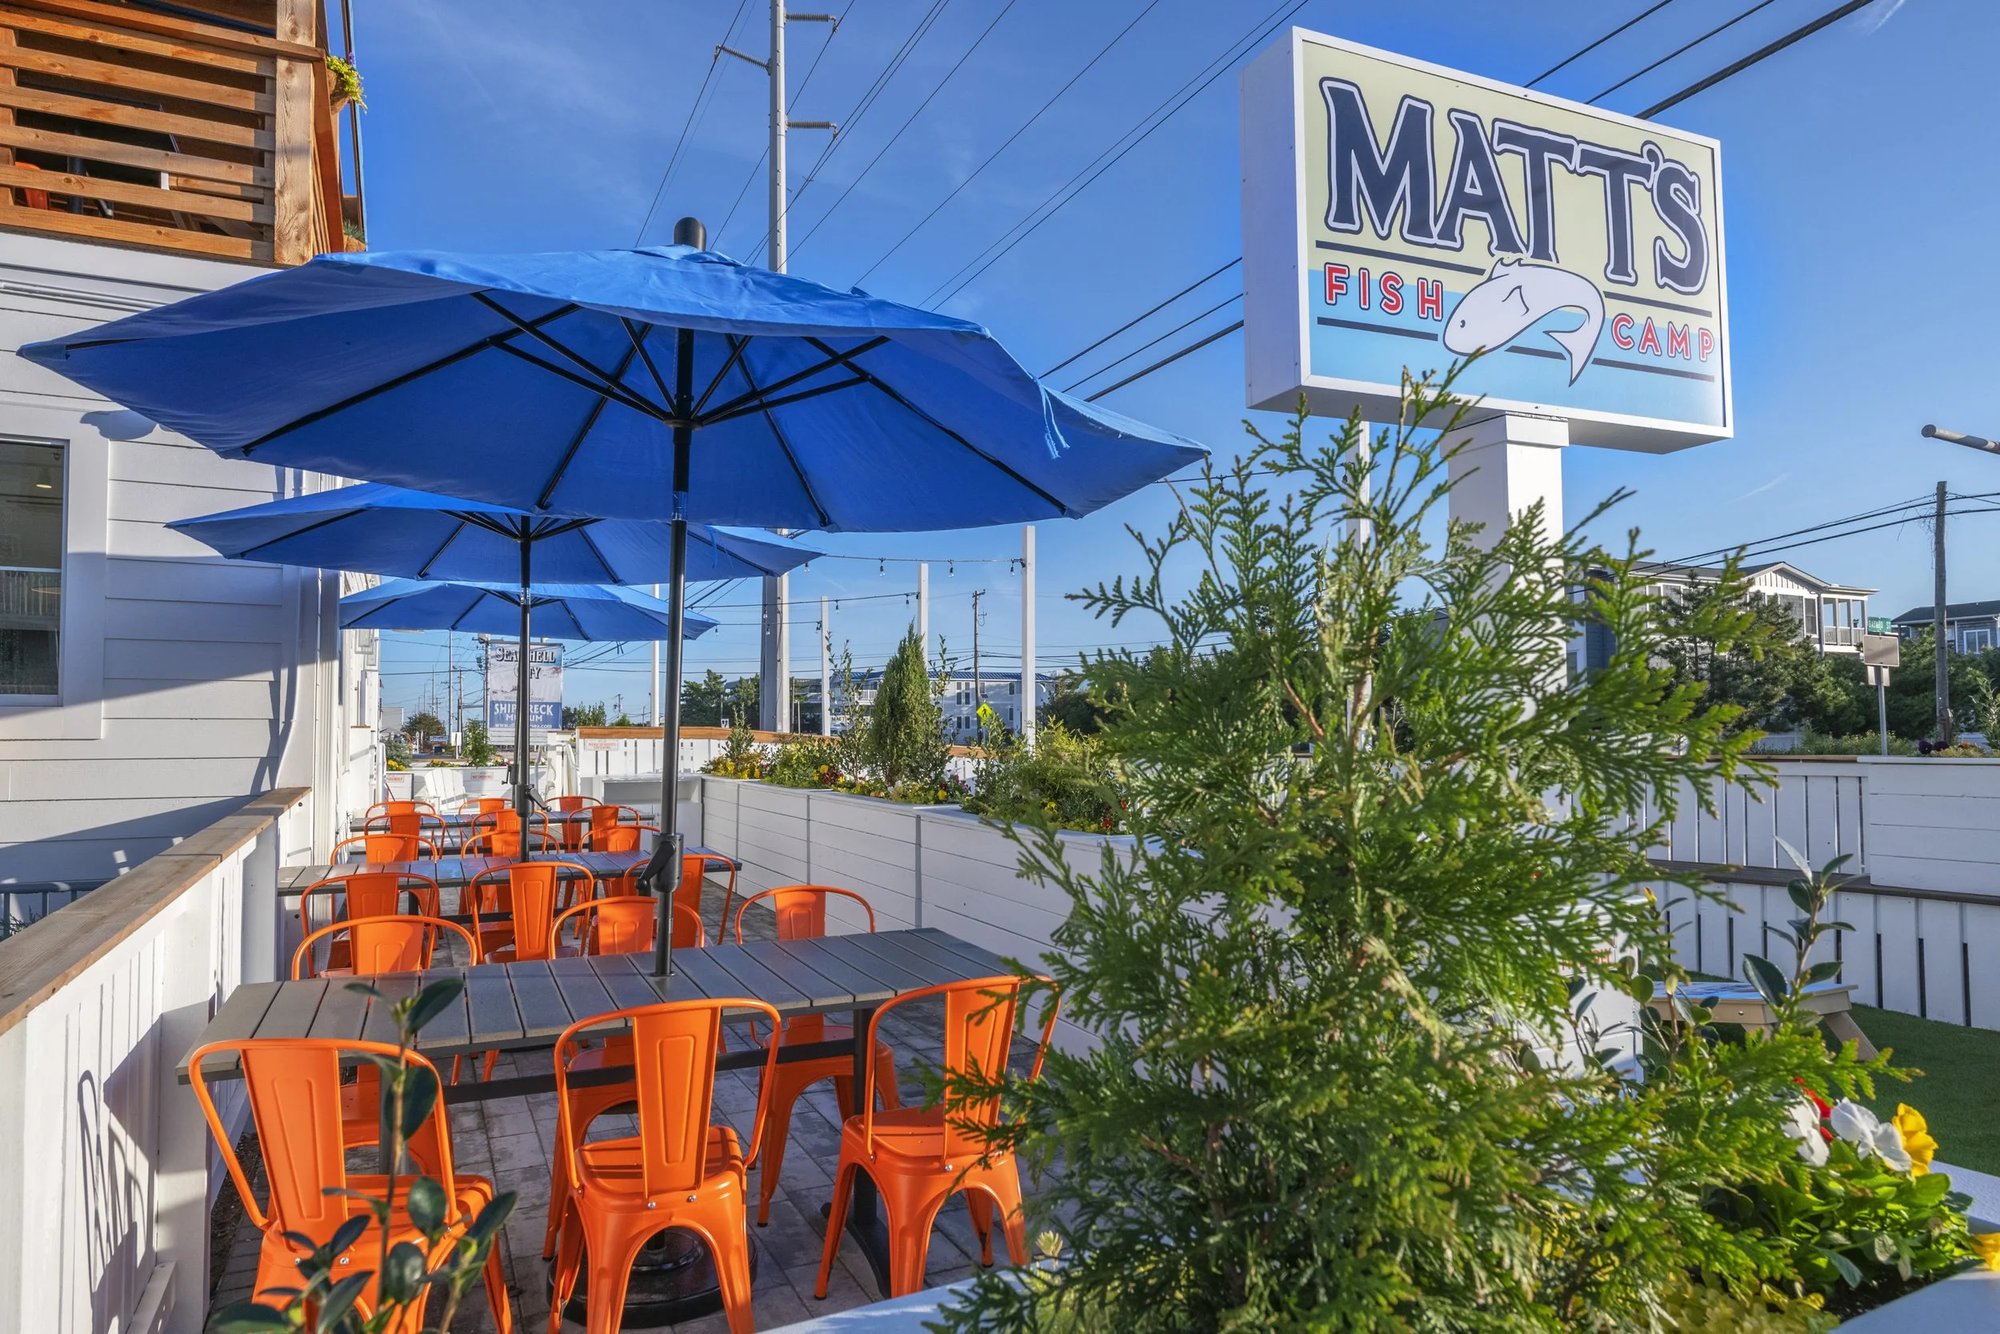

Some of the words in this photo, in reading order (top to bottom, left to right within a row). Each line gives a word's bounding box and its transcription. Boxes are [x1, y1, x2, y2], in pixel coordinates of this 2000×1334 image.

[1319, 77, 1710, 294] MATT'S
[1323, 262, 1444, 322] FISH
[1611, 313, 1716, 361] CAMP
[525, 650, 556, 663] HELL
[494, 703, 553, 717] SHIPRECK
[506, 714, 543, 722] MUM
